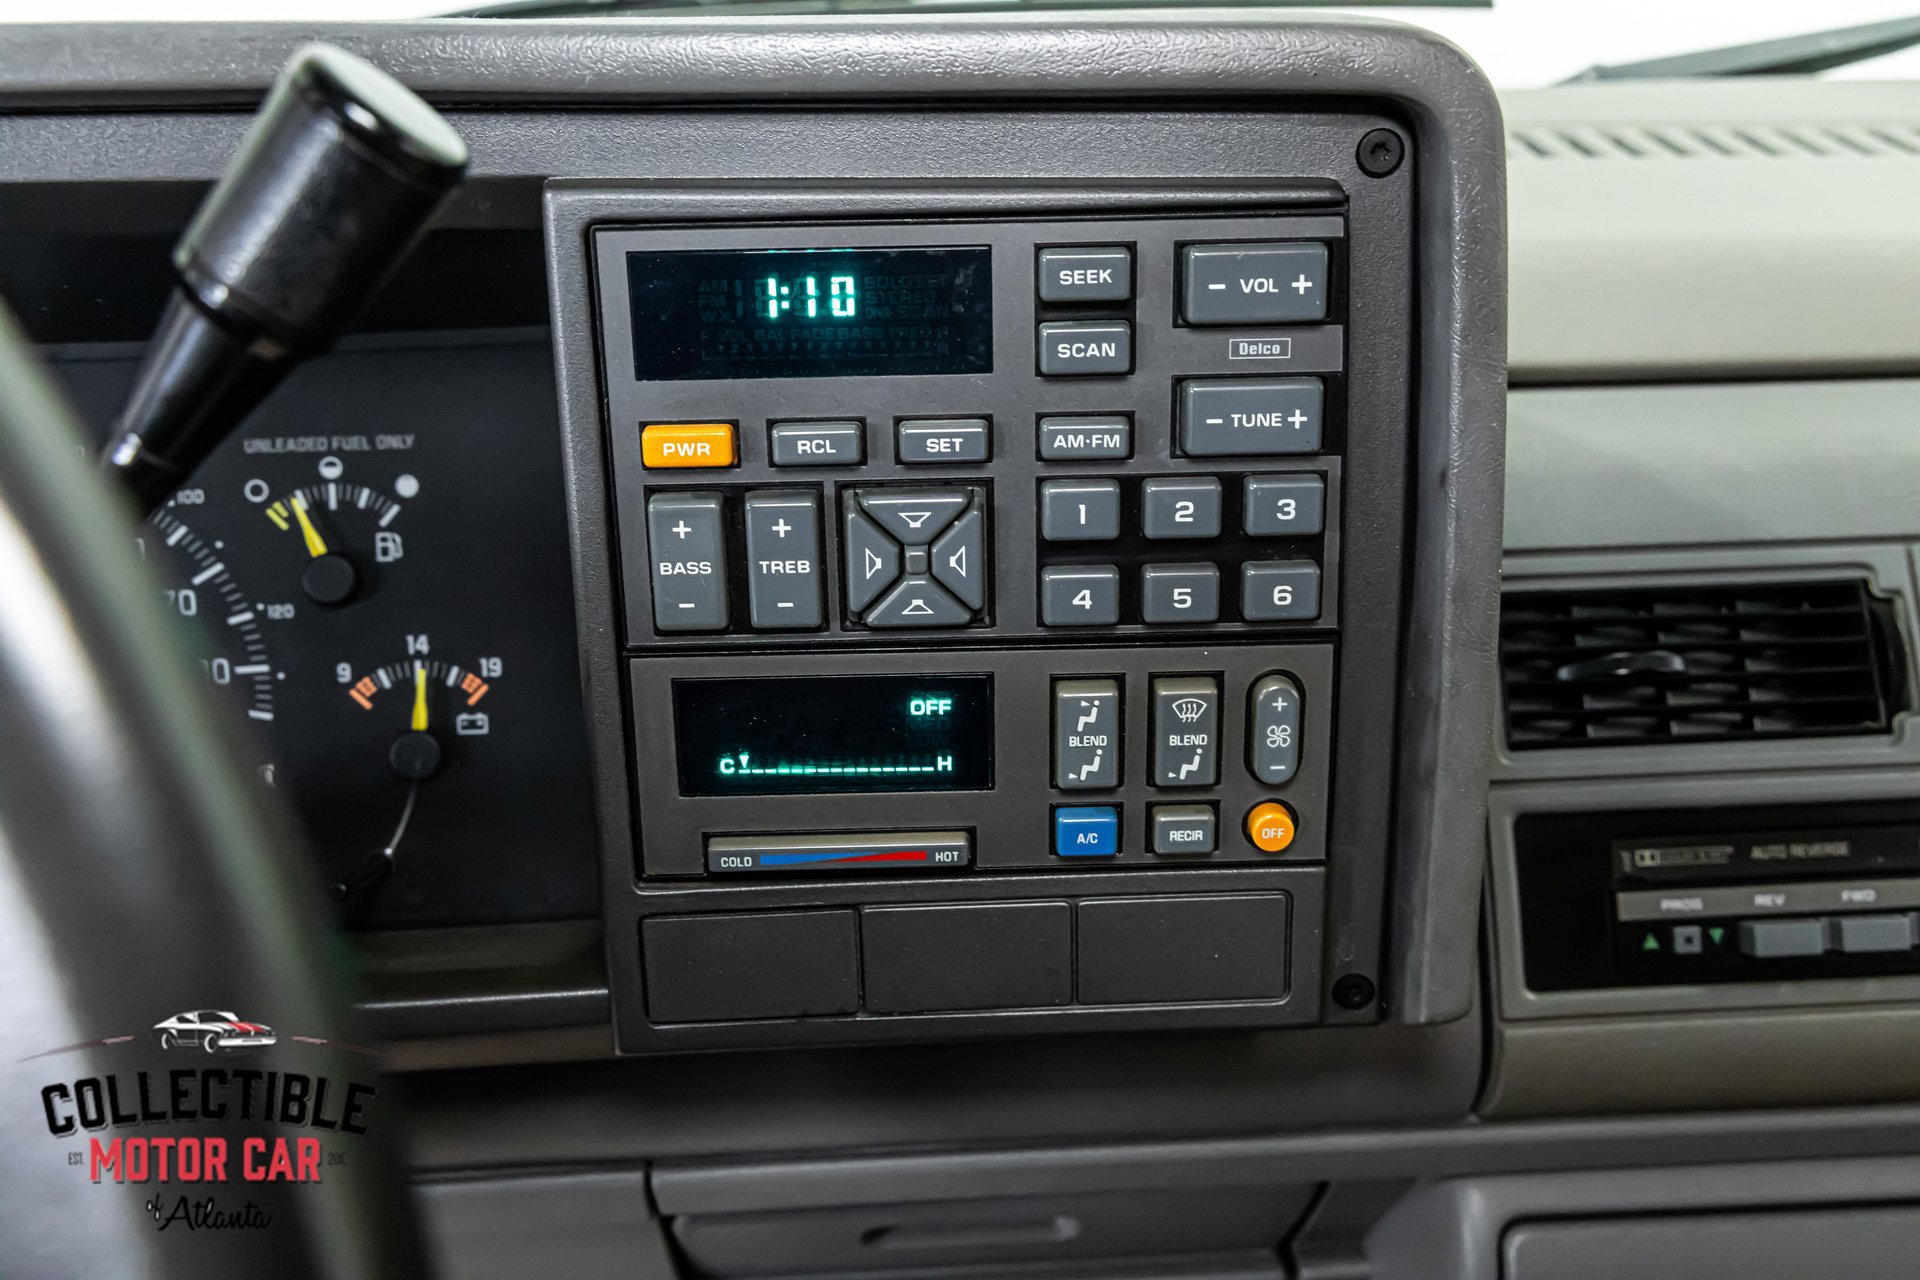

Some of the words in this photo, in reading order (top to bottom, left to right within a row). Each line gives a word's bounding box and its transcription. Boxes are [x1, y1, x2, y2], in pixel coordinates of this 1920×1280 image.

[1059, 268, 1112, 285] SEEK
[1239, 278, 1279, 294] VOL
[767, 275, 856, 319] 1:10
[1057, 342, 1116, 358] SCAN
[1238, 342, 1281, 356] Delco
[1230, 412, 1283, 428] TUNE
[243, 436, 329, 454] UNLEADED
[331, 435, 371, 451] FUEL
[375, 434, 415, 450] ONLY
[663, 442, 711, 457] PWR
[797, 439, 837, 454] RCL
[926, 438, 964, 453] SET
[177, 489, 205, 504] 100
[1078, 503, 1086, 525] 1
[1174, 501, 1195, 522] 2
[1276, 499, 1296, 520] 3
[659, 561, 712, 575] BASS
[759, 560, 811, 574] TREB
[1072, 589, 1092, 610] 4
[1172, 588, 1192, 609] 5
[1272, 585, 1293, 606] 6
[266, 603, 295, 620] 120
[406, 634, 430, 655] 14
[336, 663, 351, 683] 9
[480, 656, 503, 677] 19
[910, 699, 952, 716] OFF
[1068, 735, 1108, 748] BLEND
[1169, 734, 1208, 746] BLEND
[719, 758, 735, 774] C
[936, 755, 953, 772] H
[1076, 832, 1099, 845] A/C
[1169, 830, 1204, 842] RECIR
[1261, 827, 1285, 840] OFF
[720, 857, 753, 868] COLD
[935, 851, 959, 863] HOT
[1754, 894, 1785, 907] REV
